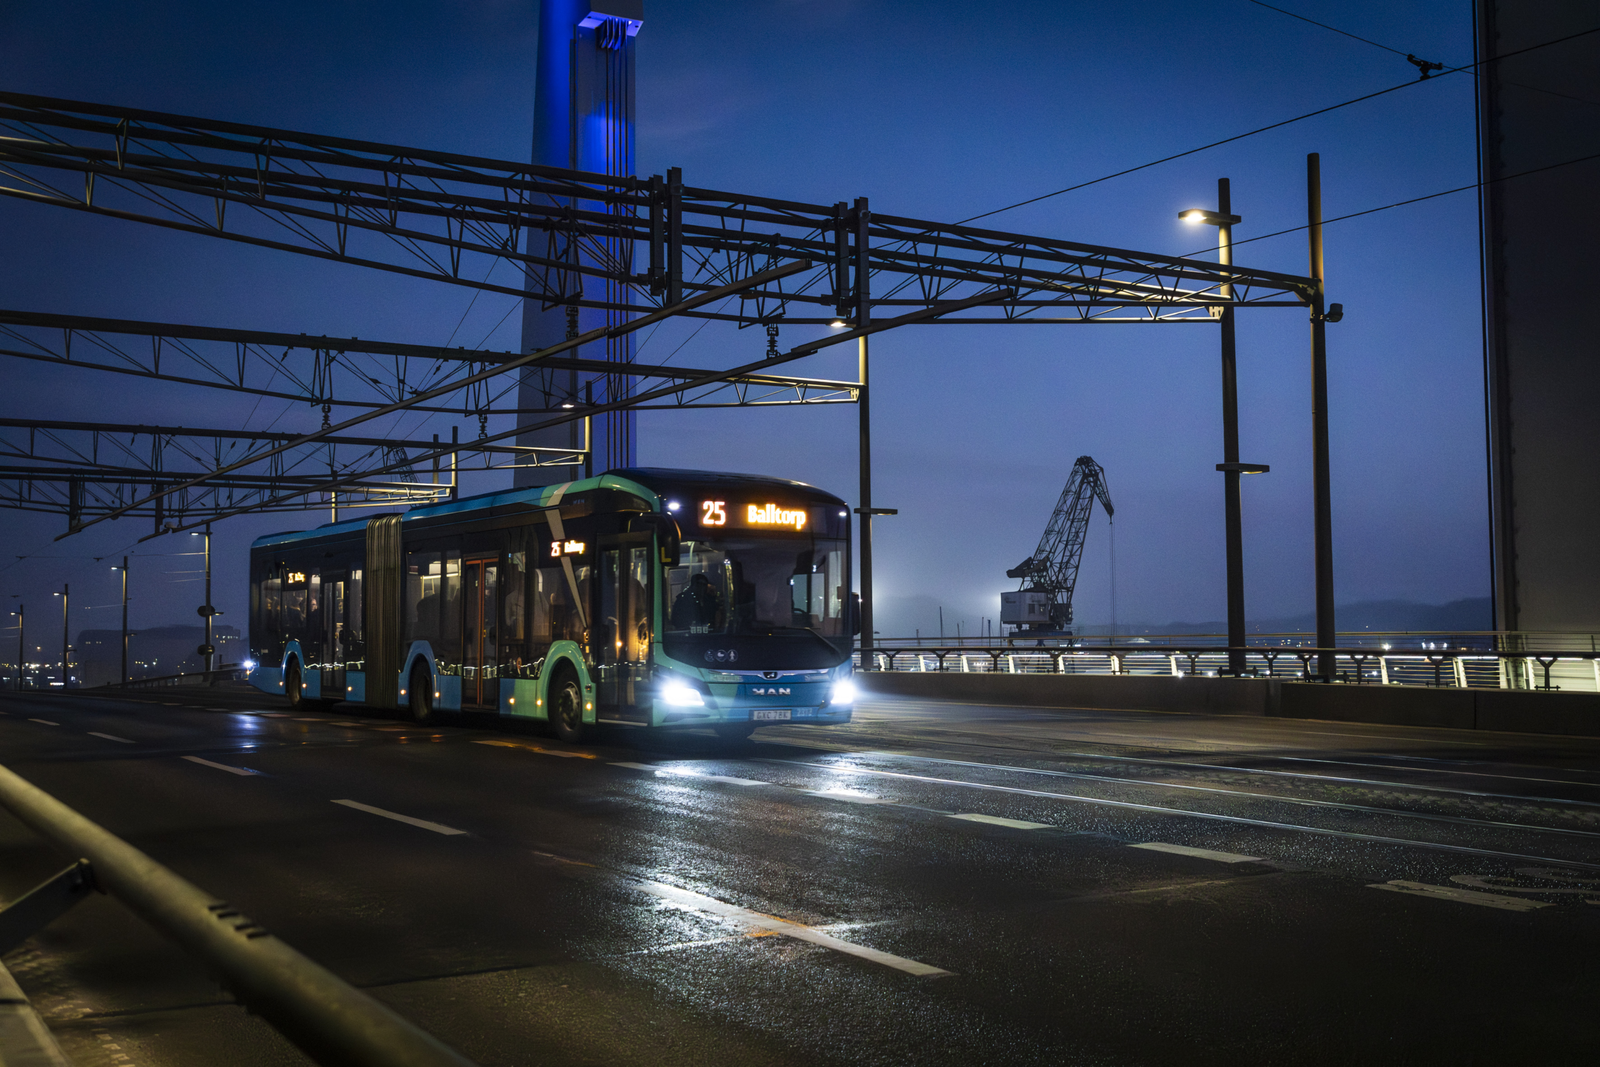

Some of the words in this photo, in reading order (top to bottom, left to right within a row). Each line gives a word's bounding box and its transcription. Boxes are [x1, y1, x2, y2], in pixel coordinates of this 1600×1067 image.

[702, 501, 726, 526] 25
[747, 503, 807, 530] Balltorp
[752, 687, 791, 696] MAN
